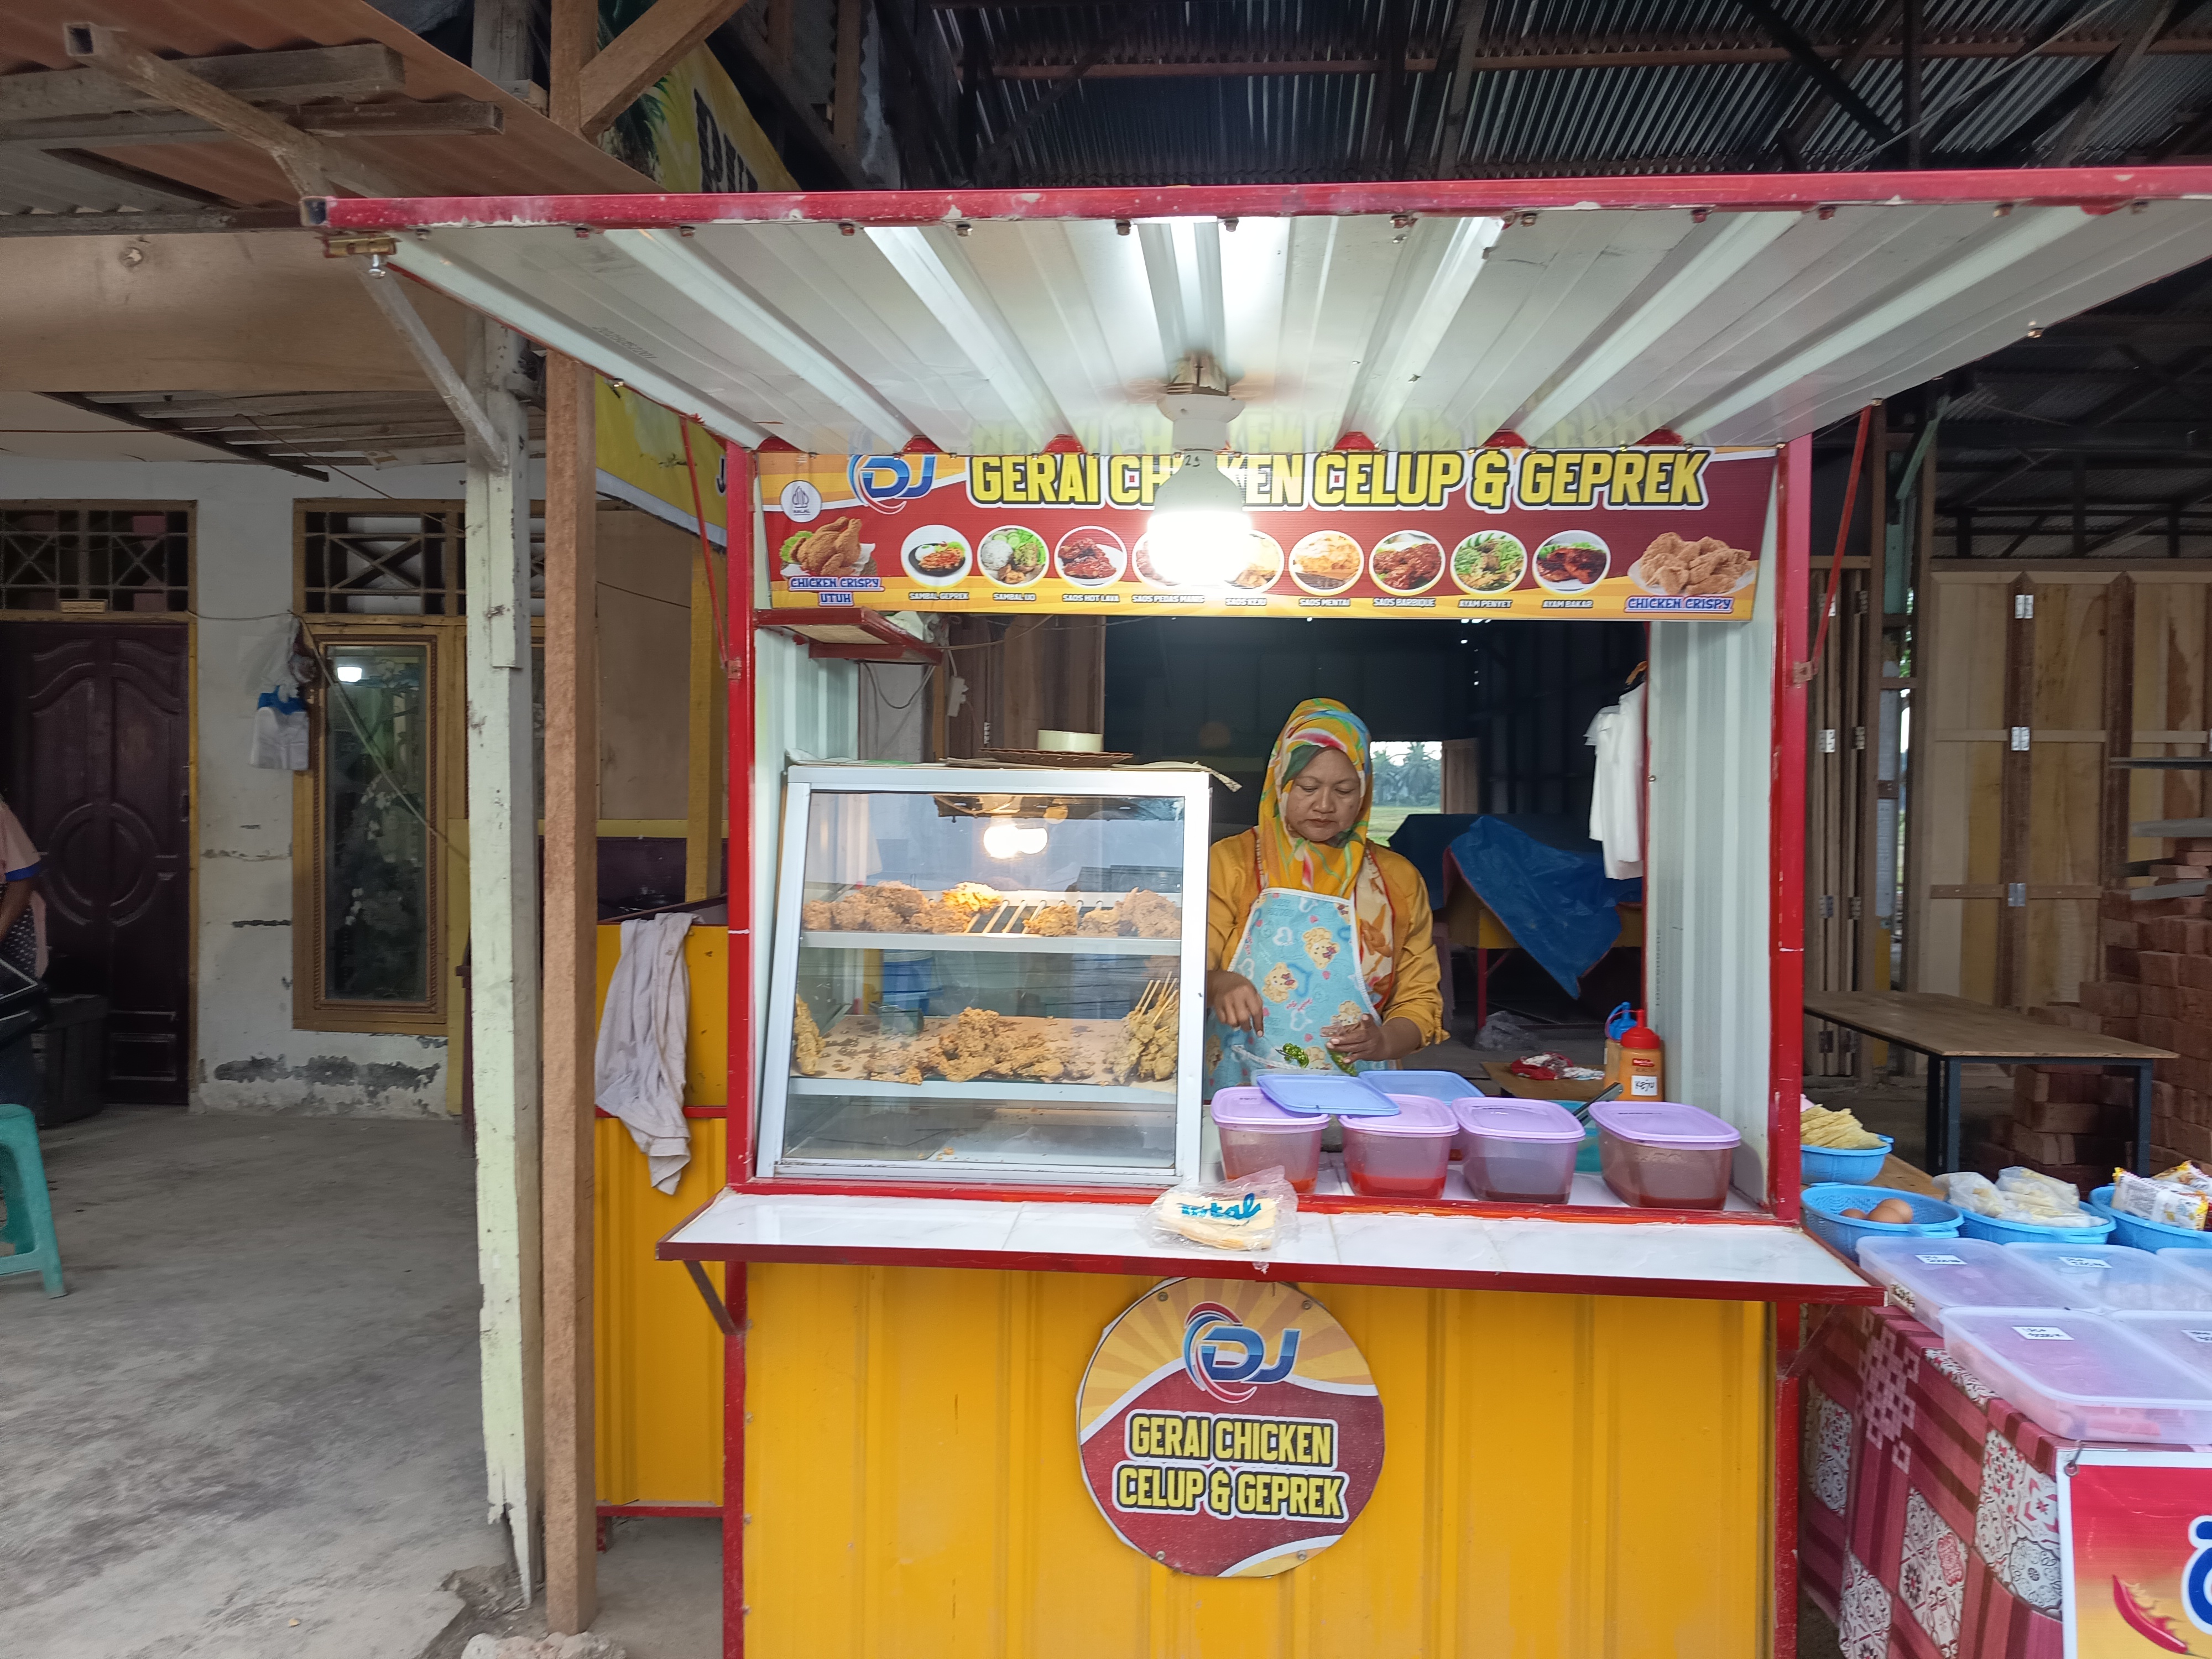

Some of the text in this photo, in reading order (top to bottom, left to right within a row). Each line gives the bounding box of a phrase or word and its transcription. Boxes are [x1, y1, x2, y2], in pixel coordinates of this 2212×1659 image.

[860, 454, 937, 499] DJ
[969, 453, 1101, 504] GERAI
[1313, 452, 1463, 506] CELUP
[1472, 450, 1510, 509] &
[1519, 450, 1710, 505] GEPREK
[790, 578, 879, 588] CHICKEN CRISPY
[821, 593, 852, 603] UTUH
[1131, 594, 1153, 603] SAOS
[1374, 598, 1395, 606] SAOS
[1628, 598, 1733, 609] CHICKEN CRISPY
[1196, 1324, 1302, 1385] DJ
[1130, 1413, 1335, 1467] GERAI CHICKEN
[1117, 1465, 1348, 1519] CELUP & GEPREK
